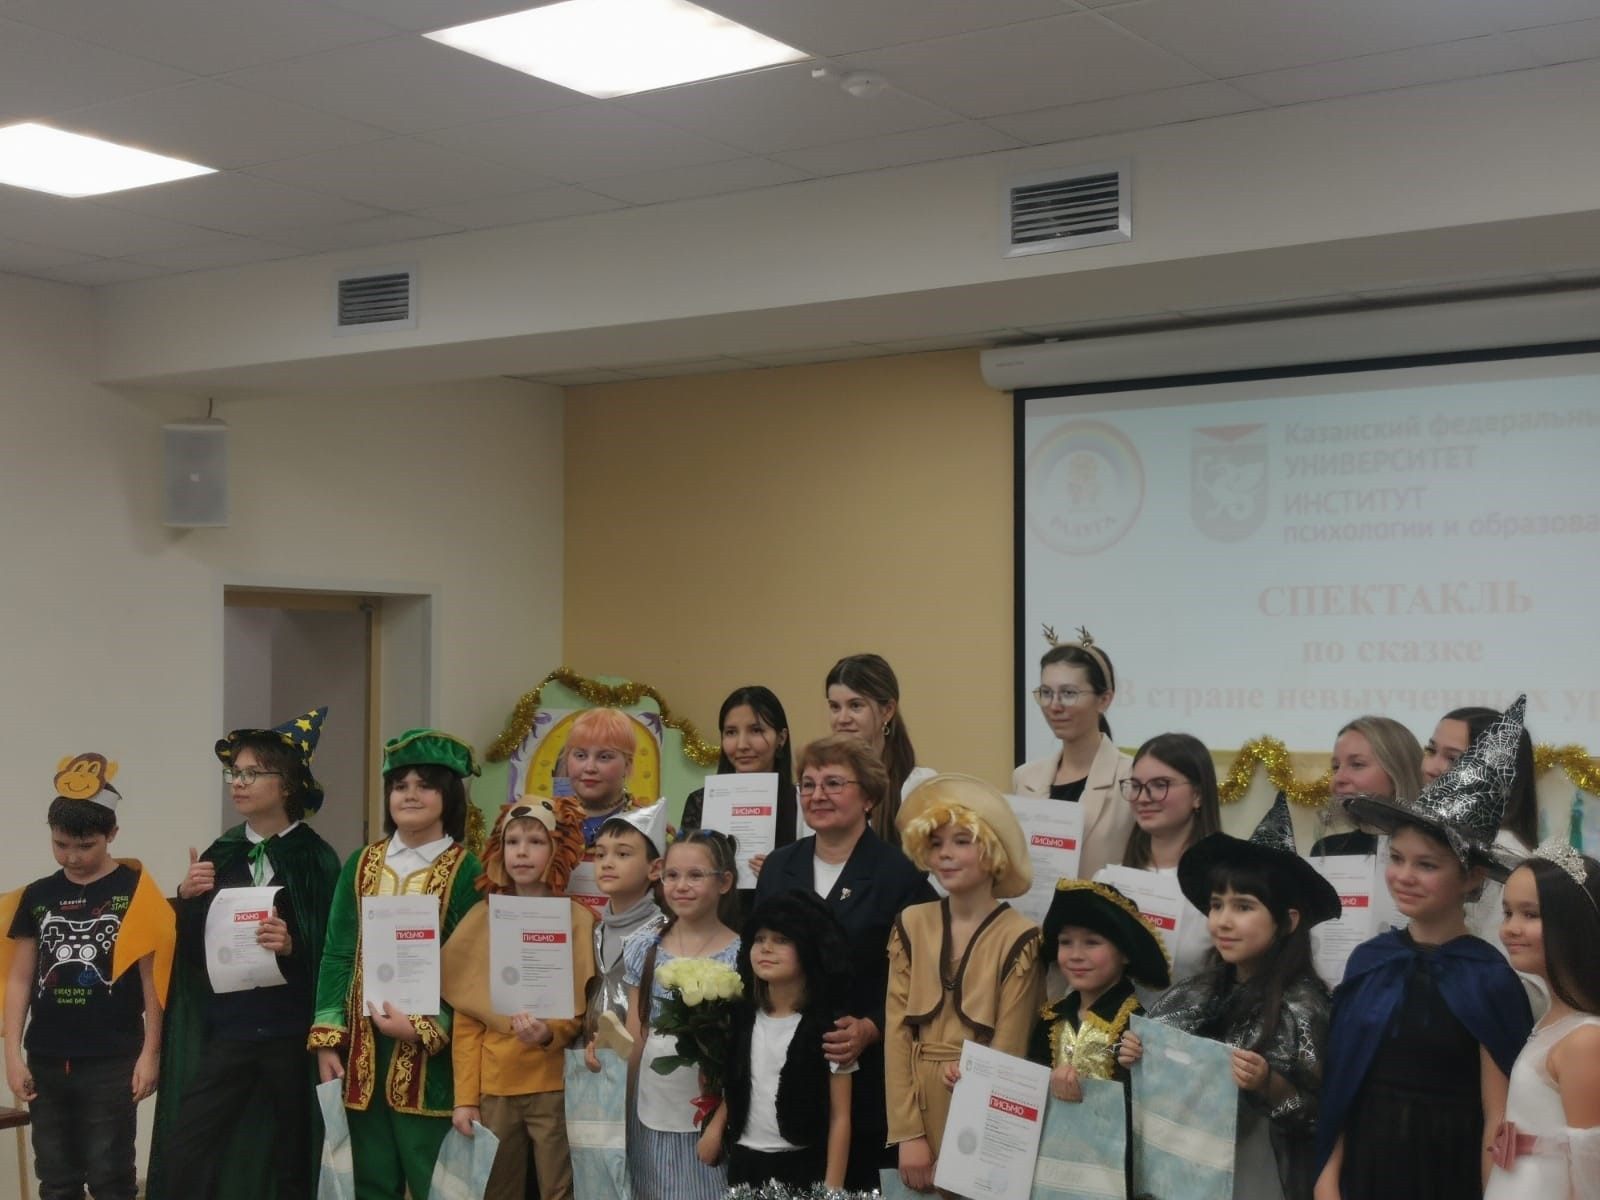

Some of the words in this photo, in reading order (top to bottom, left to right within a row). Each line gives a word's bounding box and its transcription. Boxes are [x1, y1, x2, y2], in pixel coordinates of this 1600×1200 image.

[1284, 416, 1420, 445] Казанский
[1283, 446, 1478, 479] УНИВЕРСИТЕТ
[1284, 487, 1426, 515] ИНСТИТУТ
[1283, 521, 1433, 544] психологии
[1443, 519, 1459, 537] и
[1257, 580, 1535, 616] СПЕКТАКЛЬ
[1302, 640, 1345, 664] по
[1357, 640, 1484, 664] сказке
[1147, 688, 1264, 718] стране
[1031, 835, 1064, 847] ПИСЬМО
[396, 931, 425, 939] ПИСЬМО
[523, 933, 555, 942] ПИСЬМО
[990, 1098, 1024, 1116] ПИСЬМО
